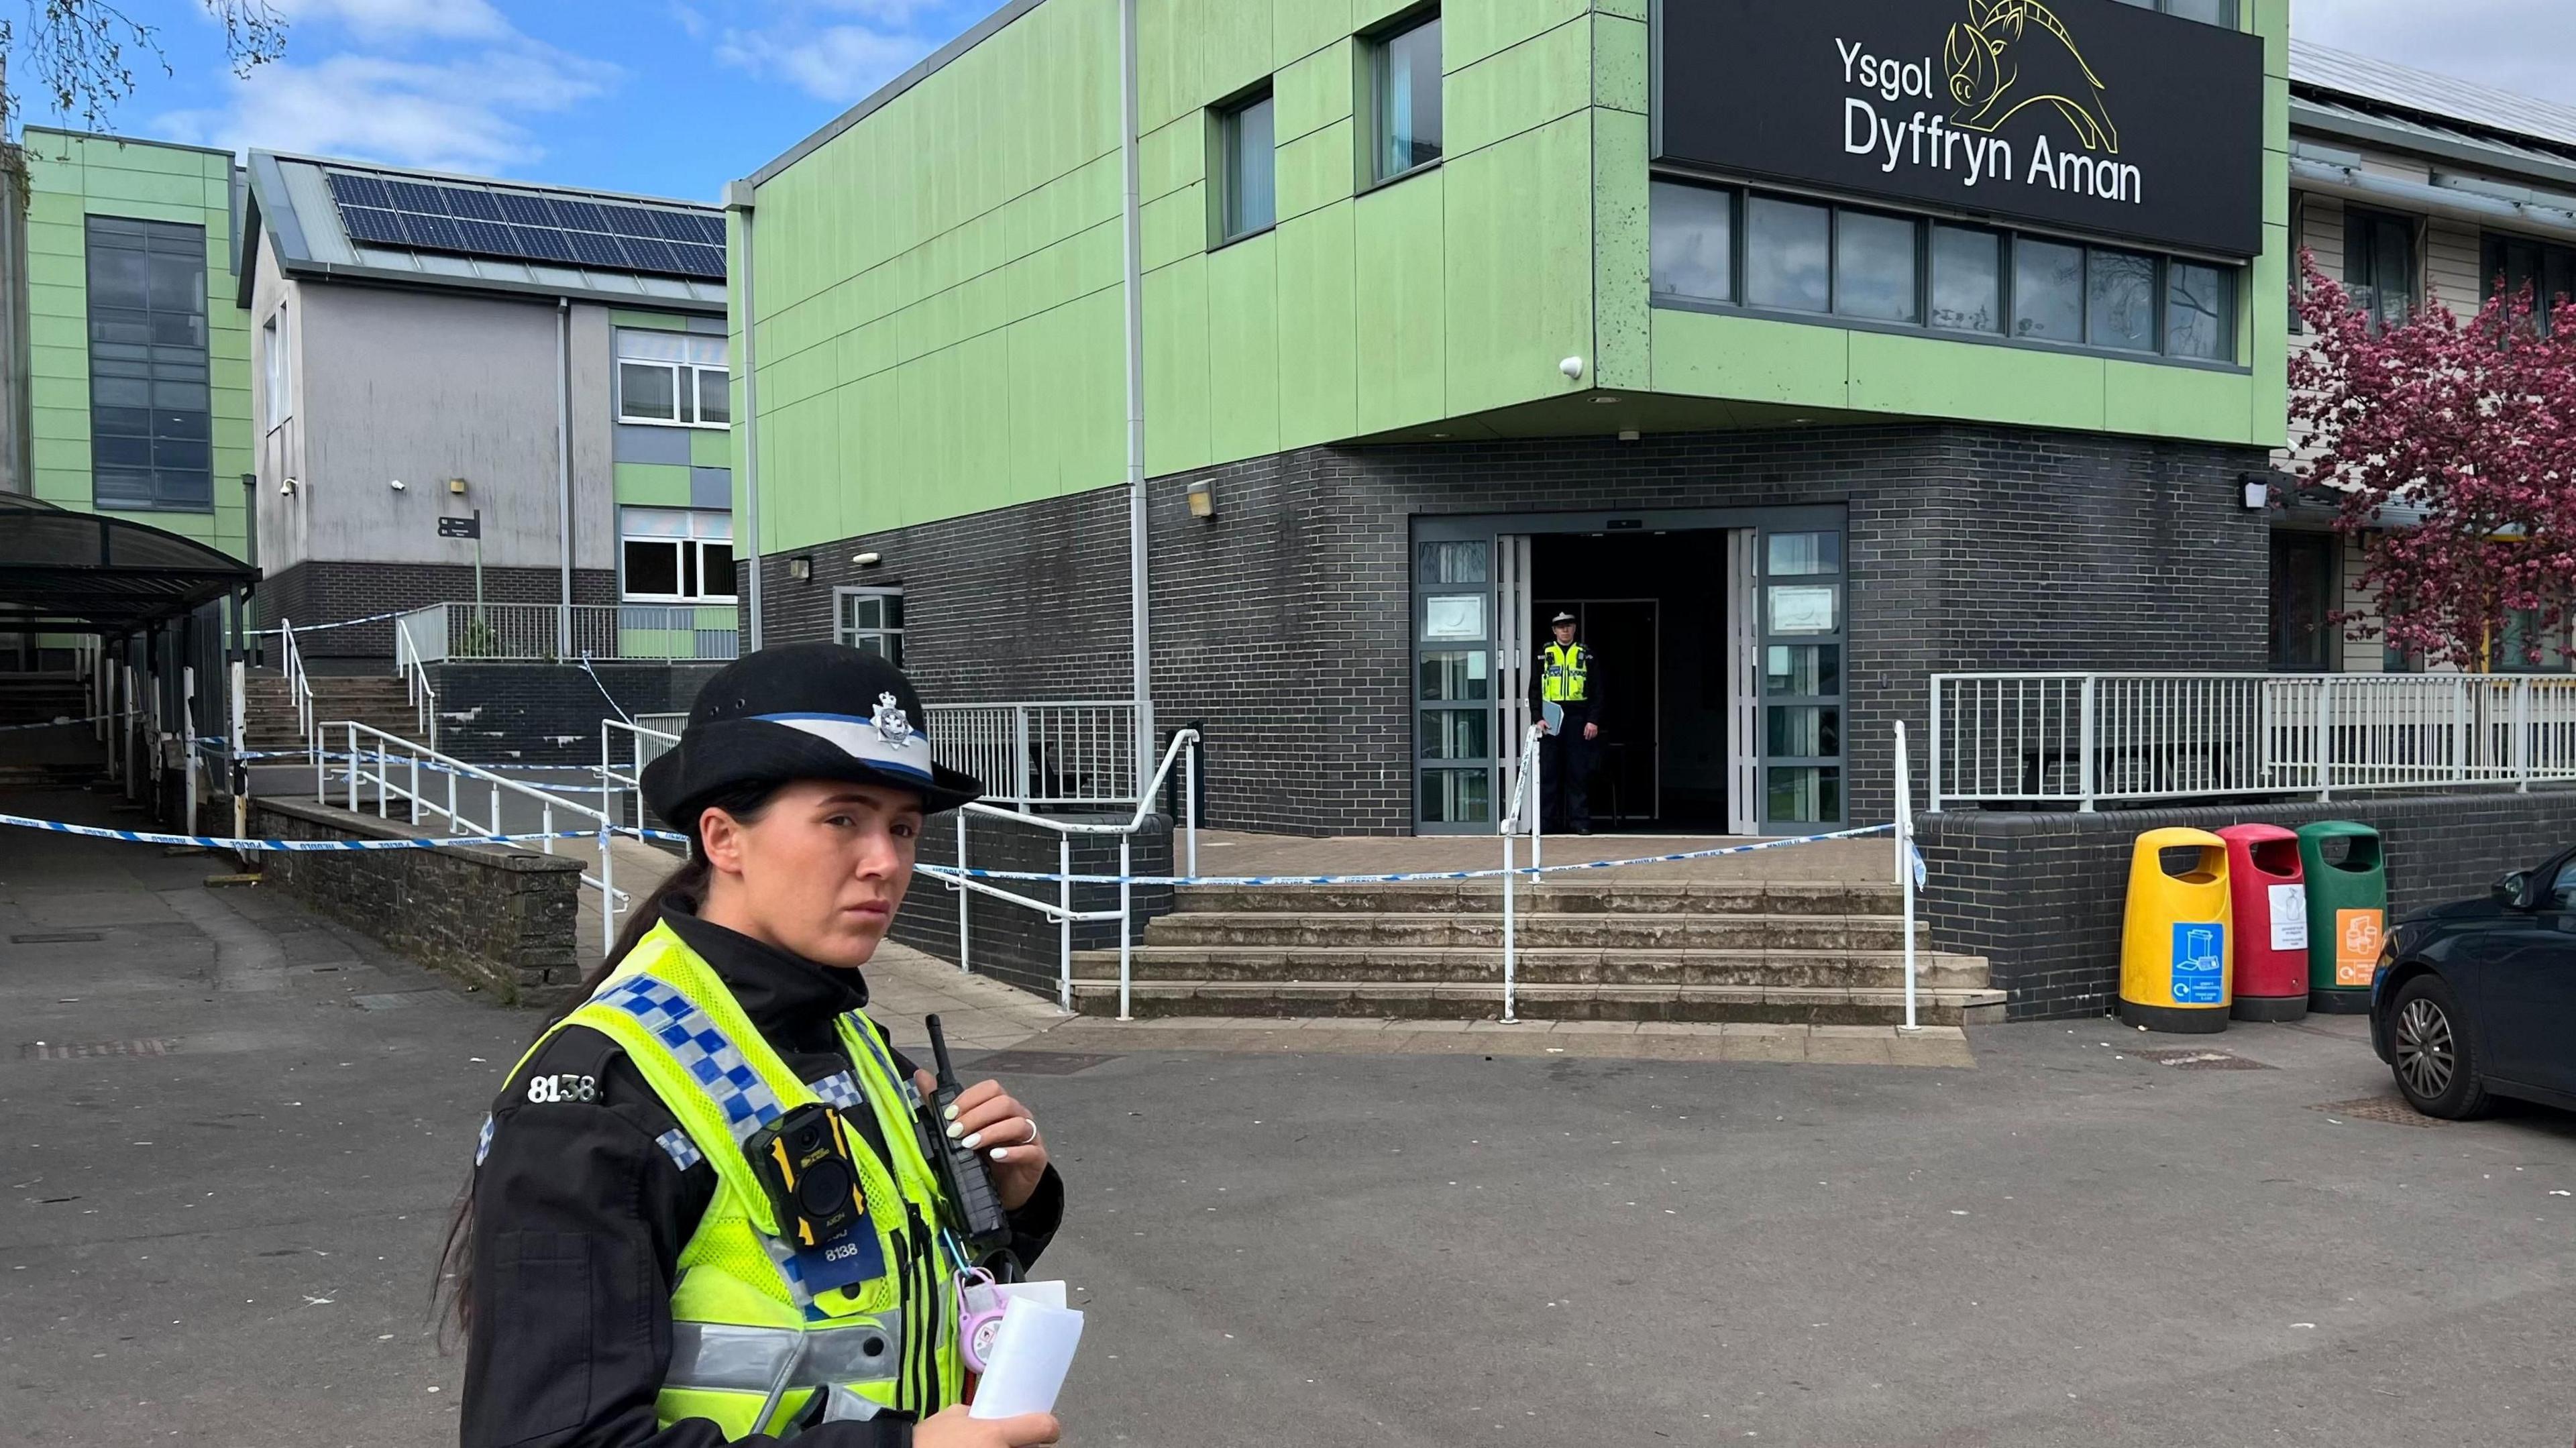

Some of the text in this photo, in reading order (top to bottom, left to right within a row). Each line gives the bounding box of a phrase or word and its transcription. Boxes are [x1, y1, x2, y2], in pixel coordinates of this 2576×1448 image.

[1835, 37, 1933, 101] Ysgol
[1844, 97, 2141, 204] Dyffryn Aman
[527, 1074, 595, 1103] 8138
[825, 1243, 858, 1262] 8138
